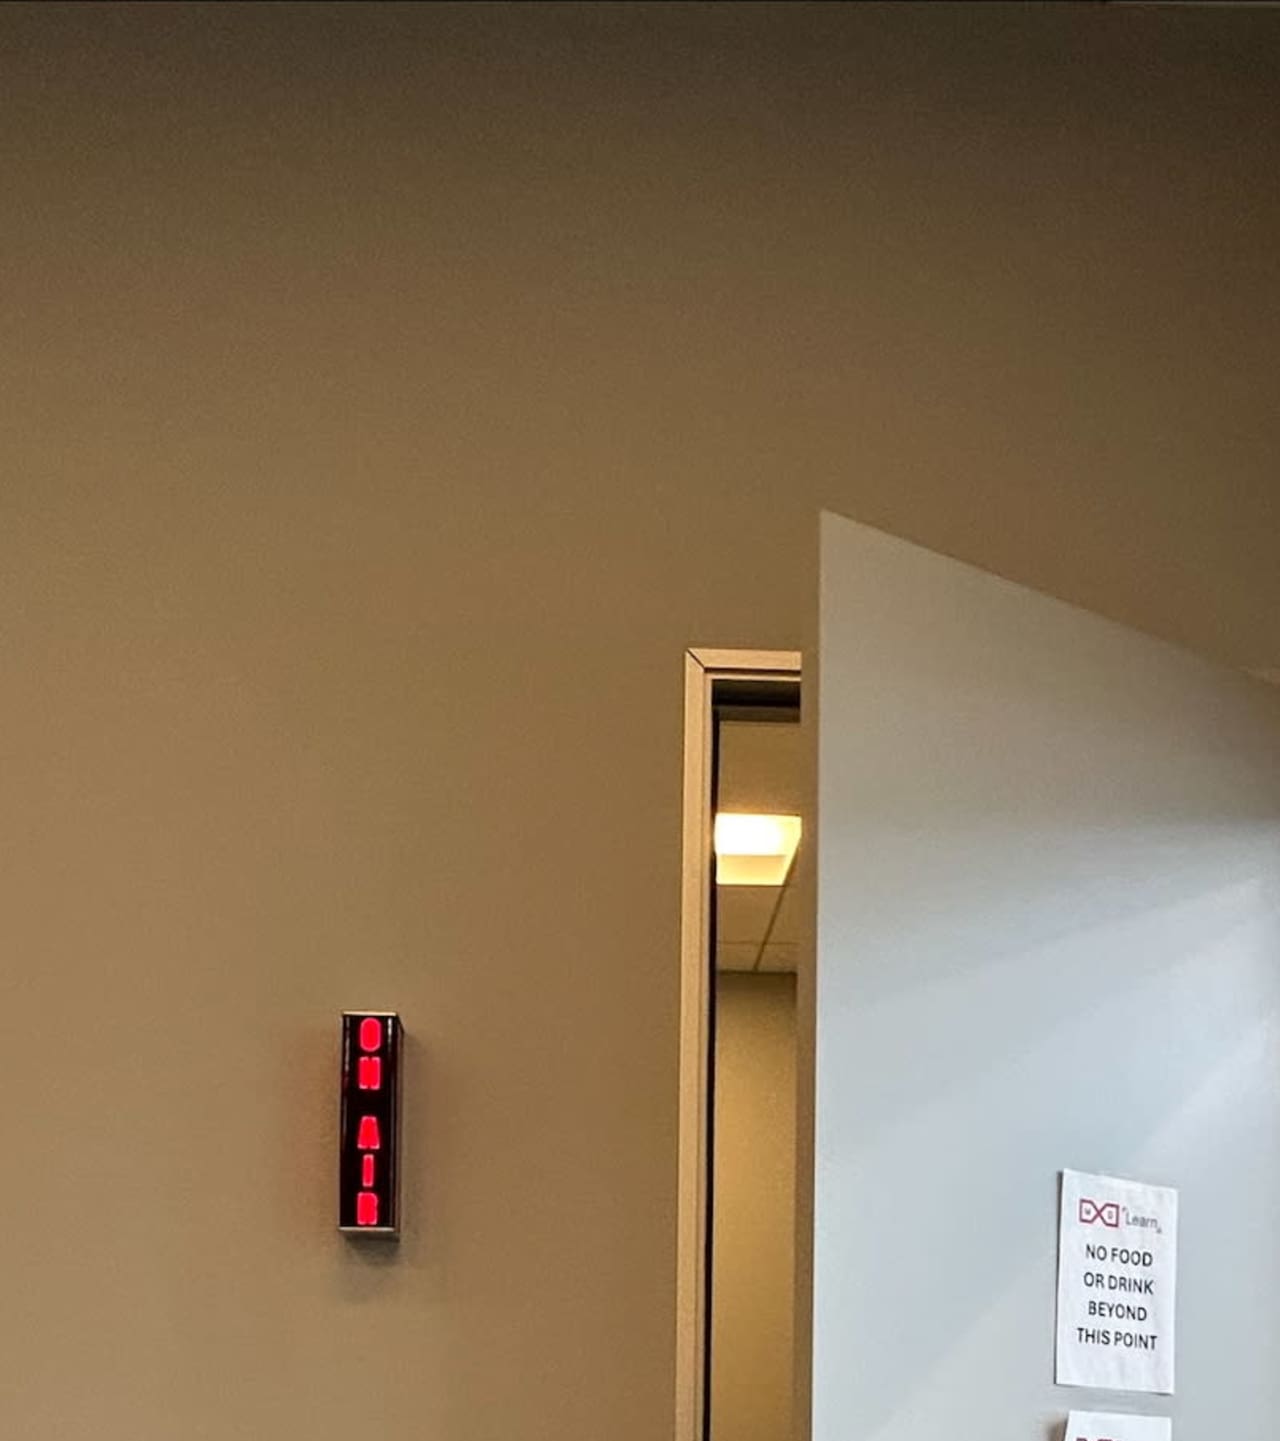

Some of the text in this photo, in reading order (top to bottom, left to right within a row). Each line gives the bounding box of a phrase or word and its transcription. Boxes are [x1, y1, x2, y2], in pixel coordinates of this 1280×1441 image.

[357, 1017, 381, 1225] ON AIR
[1085, 1243, 1154, 1267] NO FOOD
[1083, 1271, 1154, 1295] OR DRINK
[1088, 1300, 1148, 1321] BEYOND
[1077, 1327, 1158, 1350] THIS POINT
